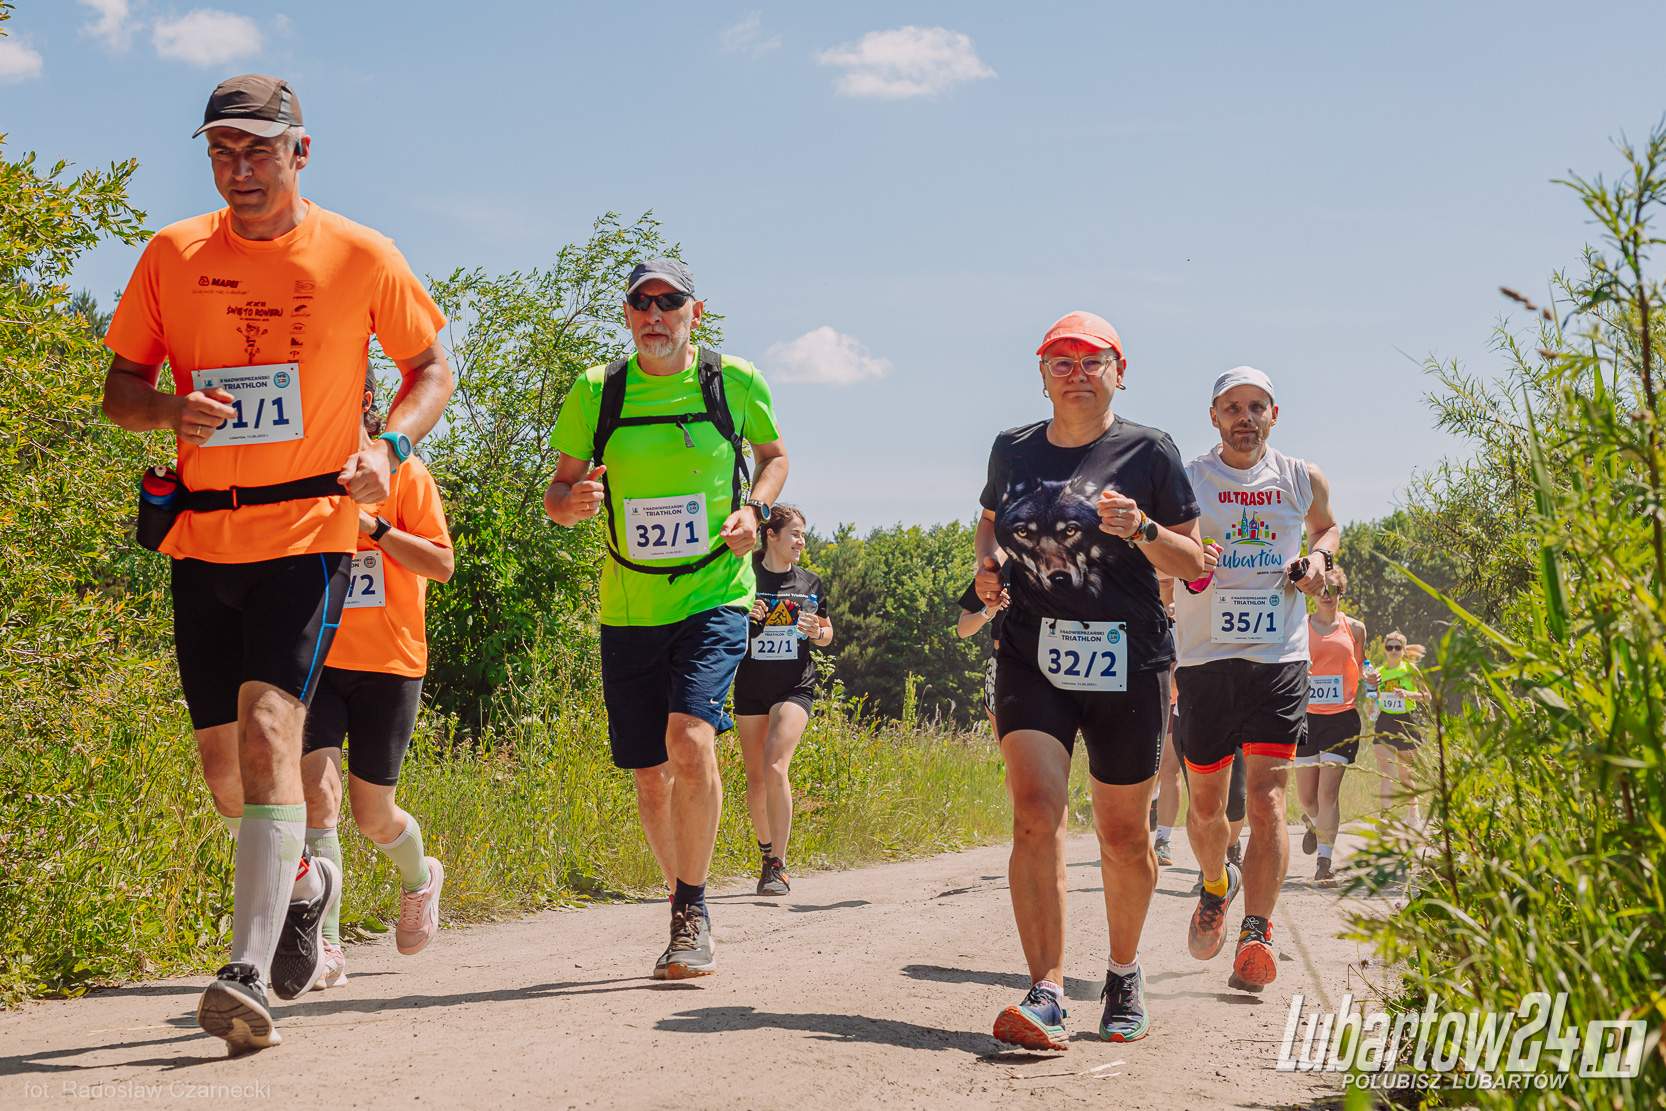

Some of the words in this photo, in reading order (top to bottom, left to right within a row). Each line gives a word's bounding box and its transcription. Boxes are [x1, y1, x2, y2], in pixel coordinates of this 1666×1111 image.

[211, 278, 239, 288] MAPEI
[223, 381, 268, 390] TRIATHLON
[215, 396, 290, 431] 1/1
[645, 509, 682, 517] TRIATHLON
[635, 520, 699, 548] 32/1
[1221, 611, 1277, 634] 35/1
[757, 640, 792, 654] 22/1
[1047, 648, 1117, 678] 32/2
[1309, 687, 1340, 699] 20/1
